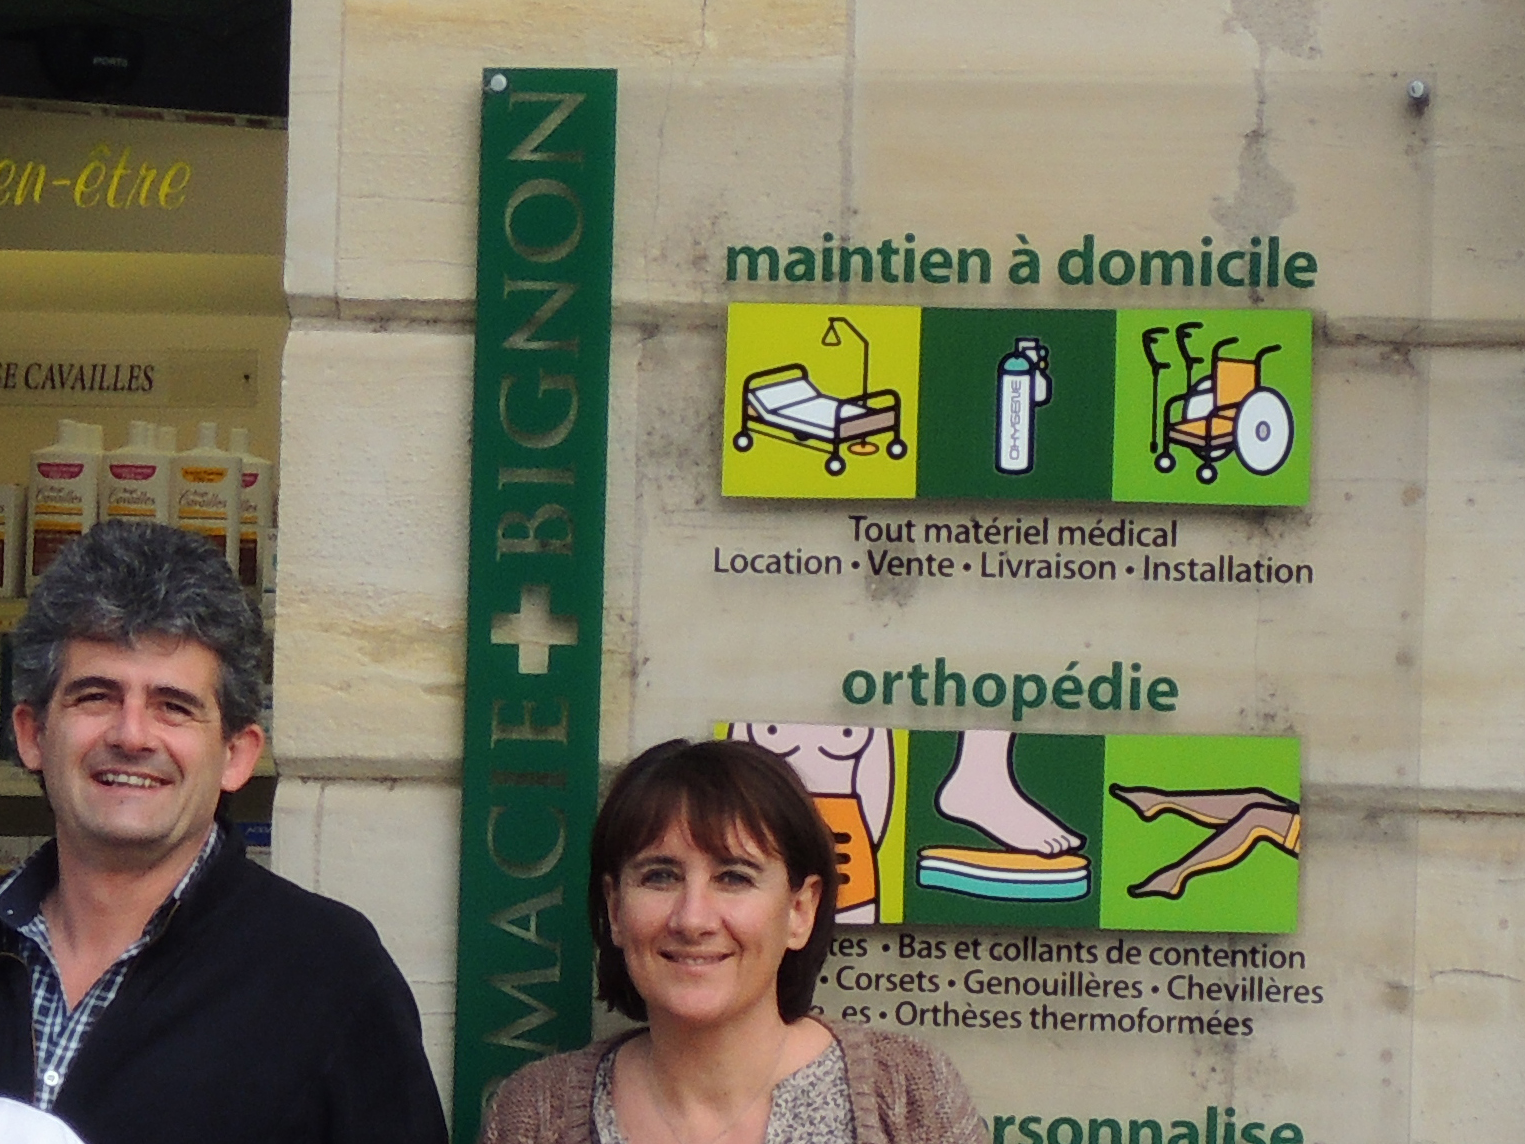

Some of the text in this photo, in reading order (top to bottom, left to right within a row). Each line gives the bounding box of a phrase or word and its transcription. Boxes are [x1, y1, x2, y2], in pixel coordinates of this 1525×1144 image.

[725, 231, 1319, 289] maintien à domicile
[494, 90, 588, 562] BIGNON
[24, 360, 156, 393] CAVAILLES
[848, 516, 1178, 549] Tout matériel médical
[714, 547, 1315, 586] Location Vente Livraison Installation
[841, 656, 1180, 721] orthopédie
[481, 699, 571, 1105] MACIE
[898, 933, 947, 960] Bas
[954, 938, 982, 961] et
[988, 936, 1099, 965] collants
[1105, 938, 1142, 966] de
[1148, 943, 1306, 969] contention
[836, 965, 1324, 1004] Corsets Genouillères Chevillères
[895, 1000, 1023, 1030] Orthèses
[1028, 1004, 1254, 1036] thermoformées
